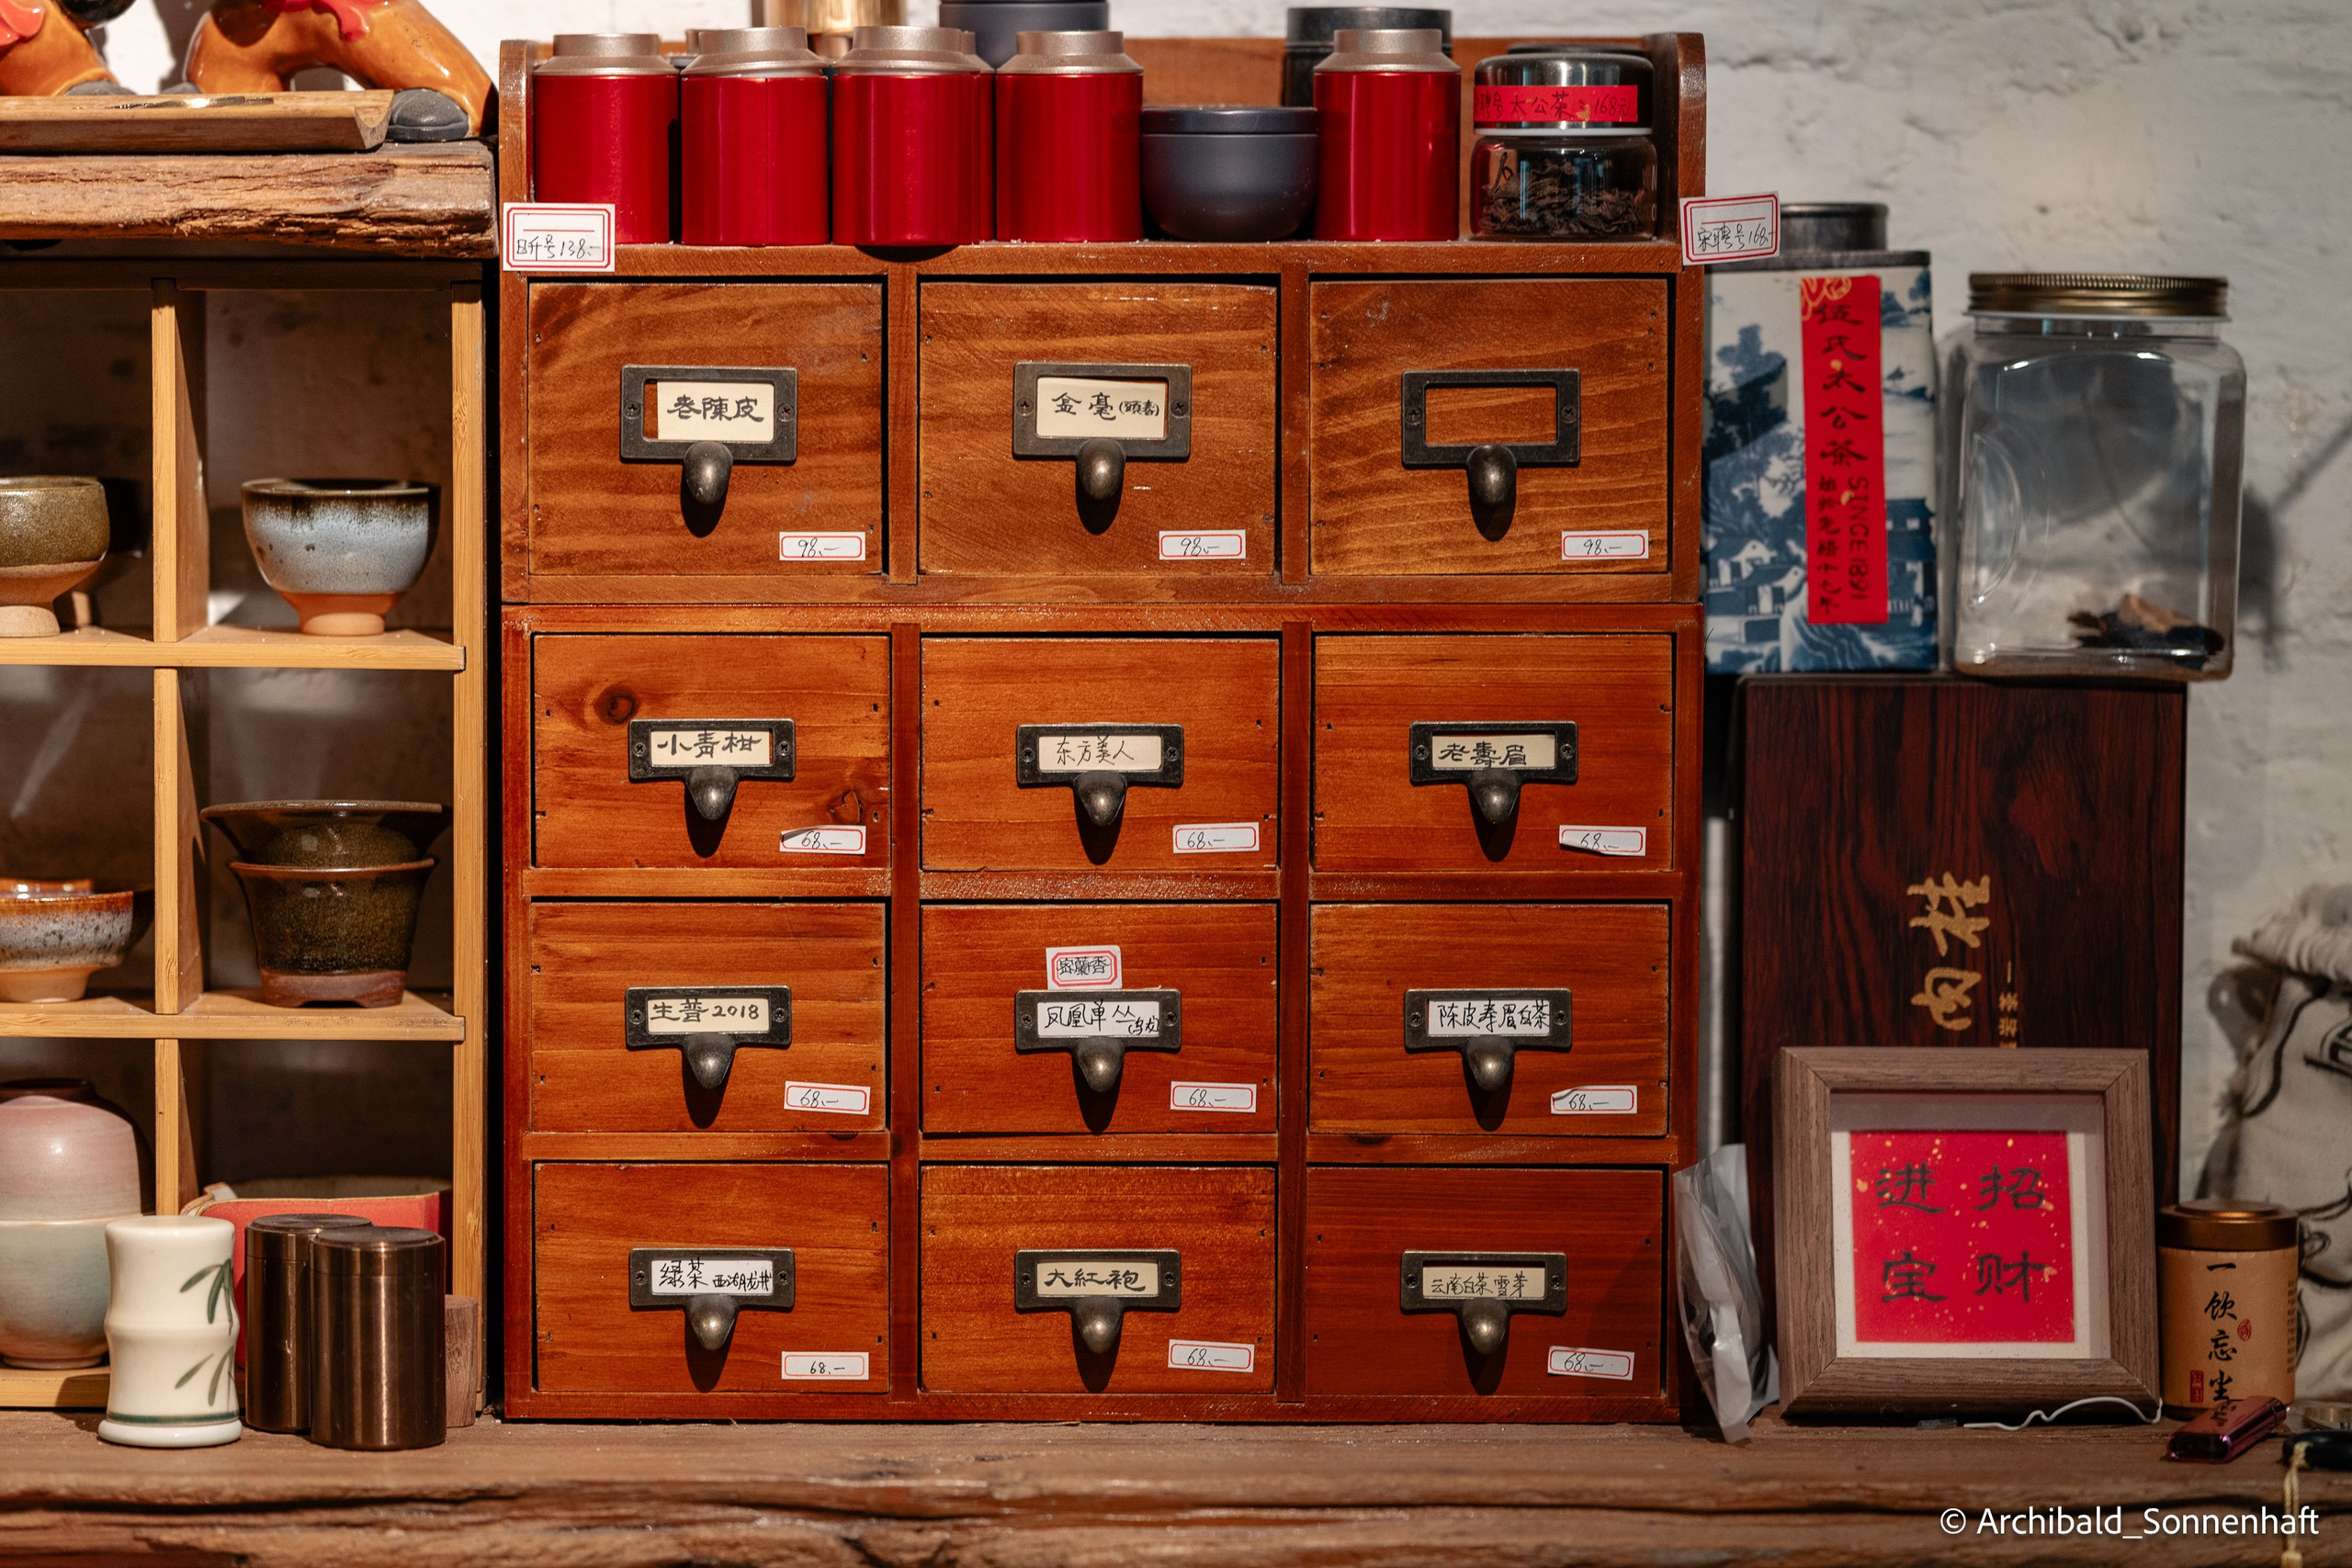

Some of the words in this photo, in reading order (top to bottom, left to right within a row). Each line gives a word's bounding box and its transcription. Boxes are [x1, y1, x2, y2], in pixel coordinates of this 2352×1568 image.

[1848, 476, 1870, 553] SINCE
[1849, 558, 1870, 600] 1891
[657, 729, 762, 758] 小青柑
[1057, 735, 1135, 766] 东方美人
[659, 1257, 708, 1289] 绿茶
[1044, 1269, 1146, 1292] 大紅袍
